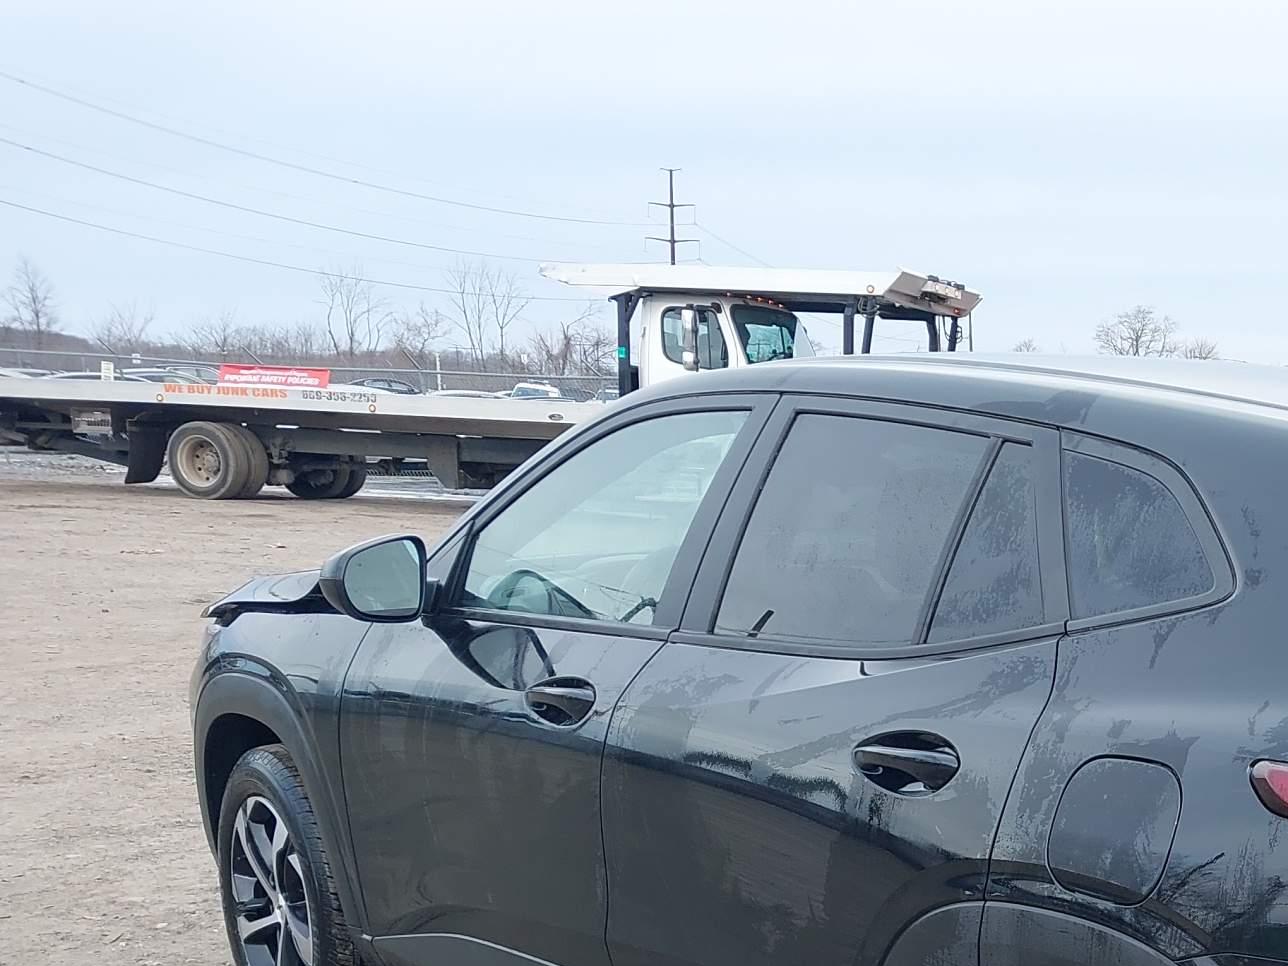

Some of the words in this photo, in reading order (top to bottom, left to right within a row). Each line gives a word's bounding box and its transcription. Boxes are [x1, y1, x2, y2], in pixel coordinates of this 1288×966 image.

[261, 375, 287, 384] SAFETY
[164, 383, 185, 394] WE
[187, 384, 212, 395] BUY
[216, 386, 248, 397] JUNK
[252, 388, 289, 399] CARS
